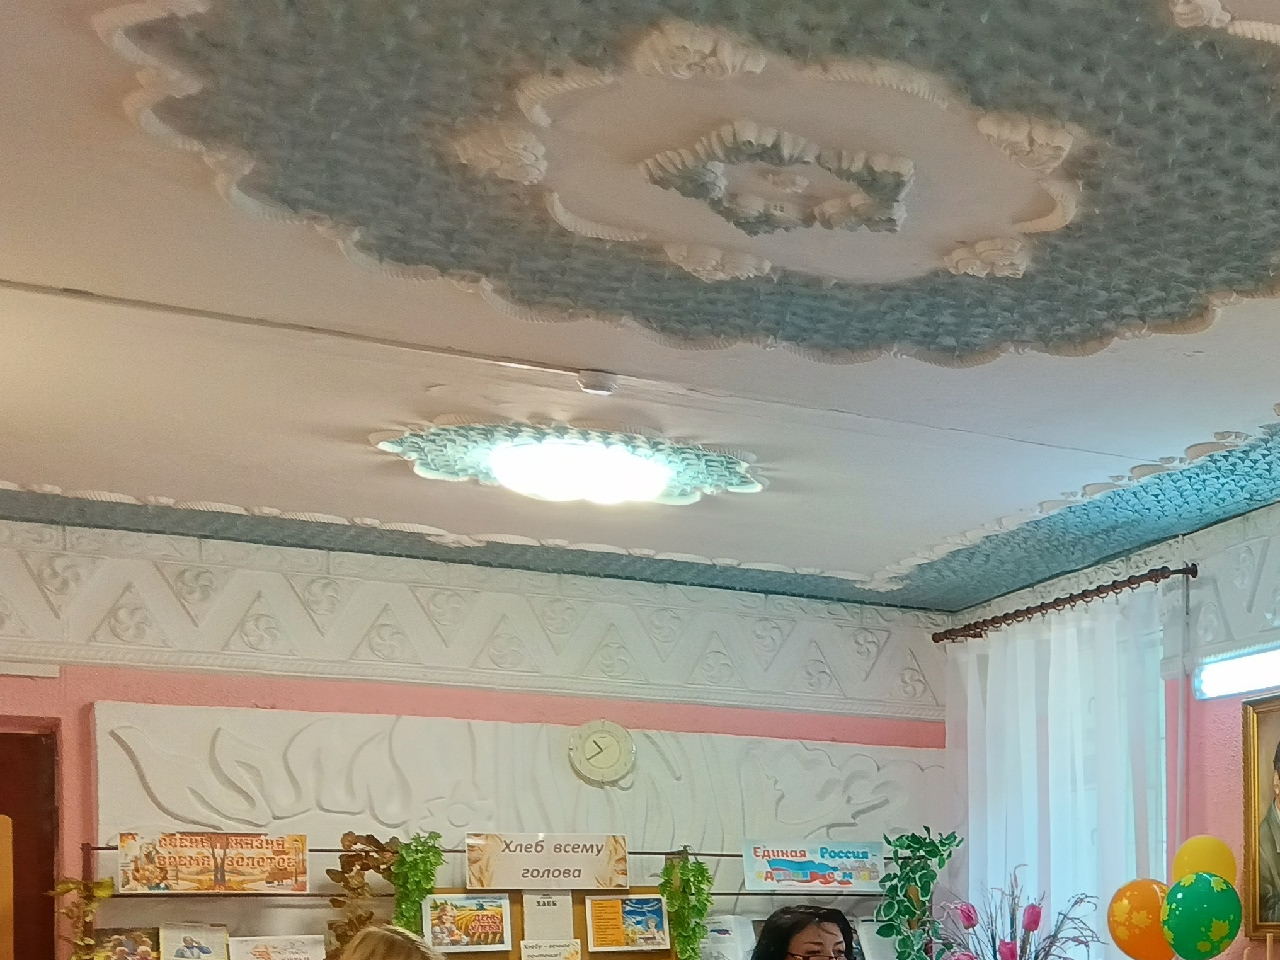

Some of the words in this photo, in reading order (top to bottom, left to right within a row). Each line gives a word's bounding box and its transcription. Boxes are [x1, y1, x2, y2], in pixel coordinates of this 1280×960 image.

[501, 840, 545, 853] Хлеб
[553, 842, 604, 856] всему
[753, 847, 807, 860] Единая
[820, 847, 869, 860] Россия
[156, 855, 211, 868] ВРЕМЯ
[225, 855, 296, 869] ЗОЛОТОЕ
[521, 868, 582, 879] голова
